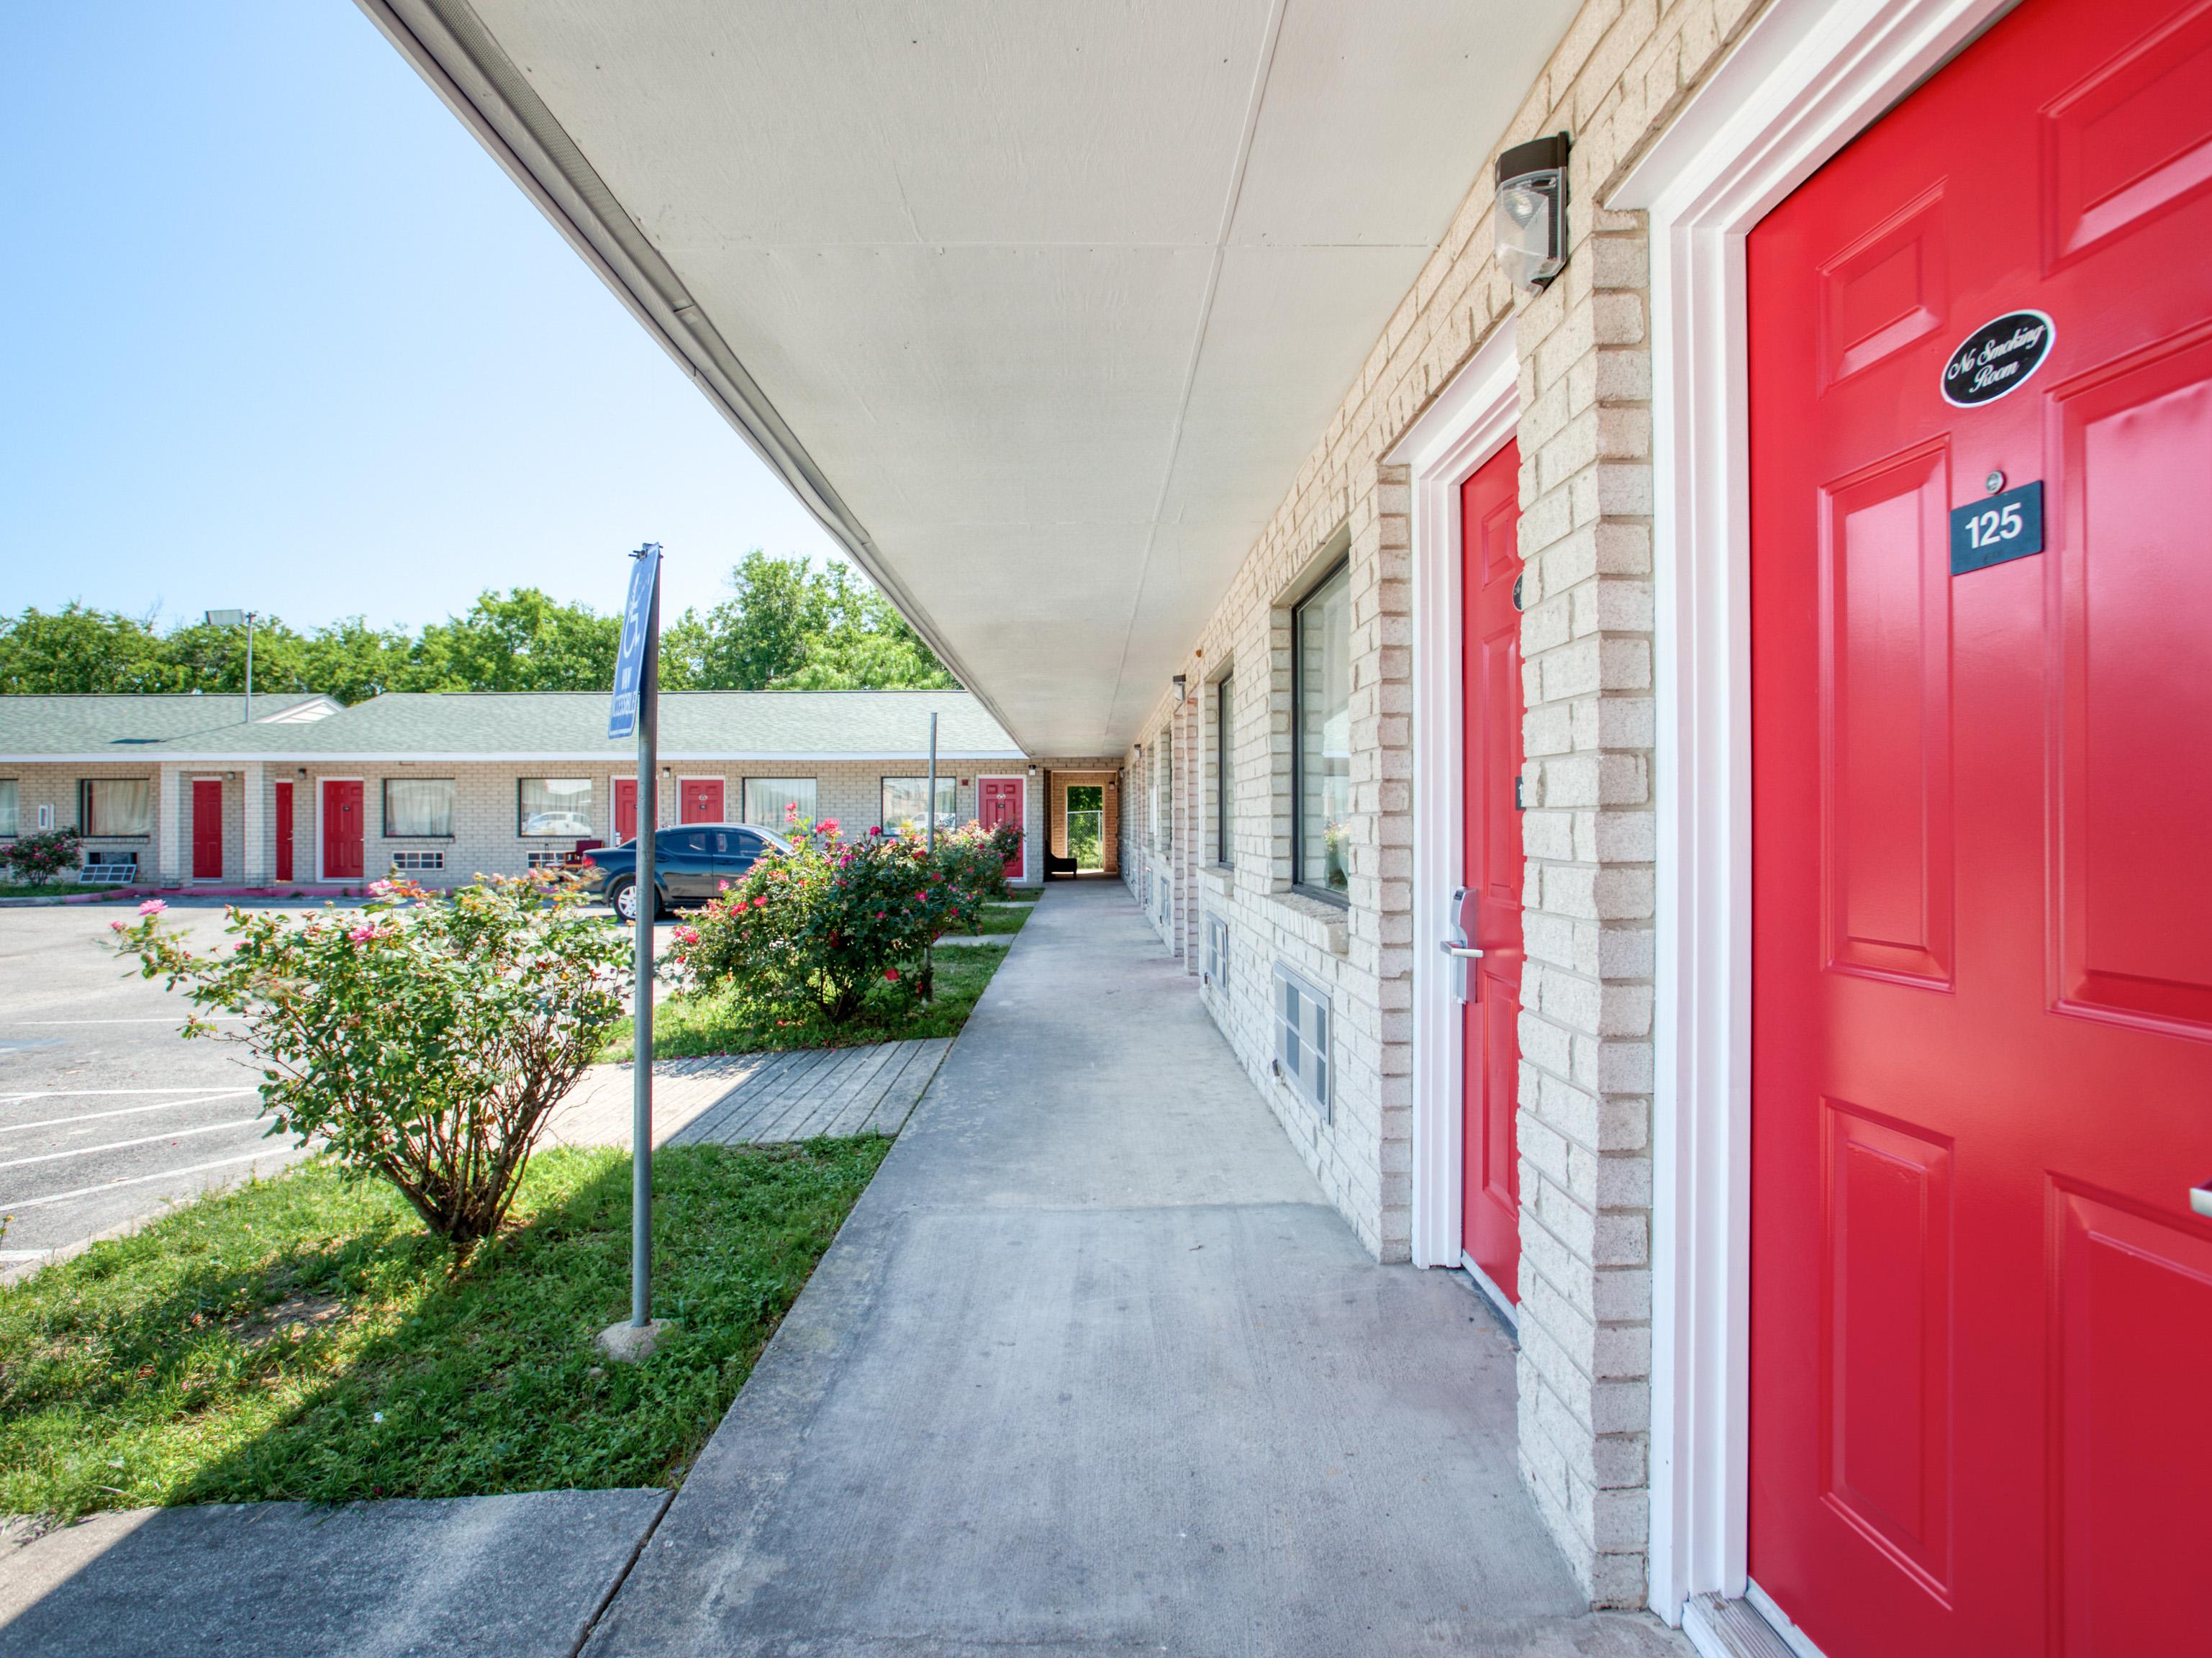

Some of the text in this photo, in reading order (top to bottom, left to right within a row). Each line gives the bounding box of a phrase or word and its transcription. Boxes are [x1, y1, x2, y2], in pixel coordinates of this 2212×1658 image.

[1947, 325, 2046, 381] No Smoking
[1970, 361, 2020, 392] Room
[1965, 502, 2022, 548] 125
